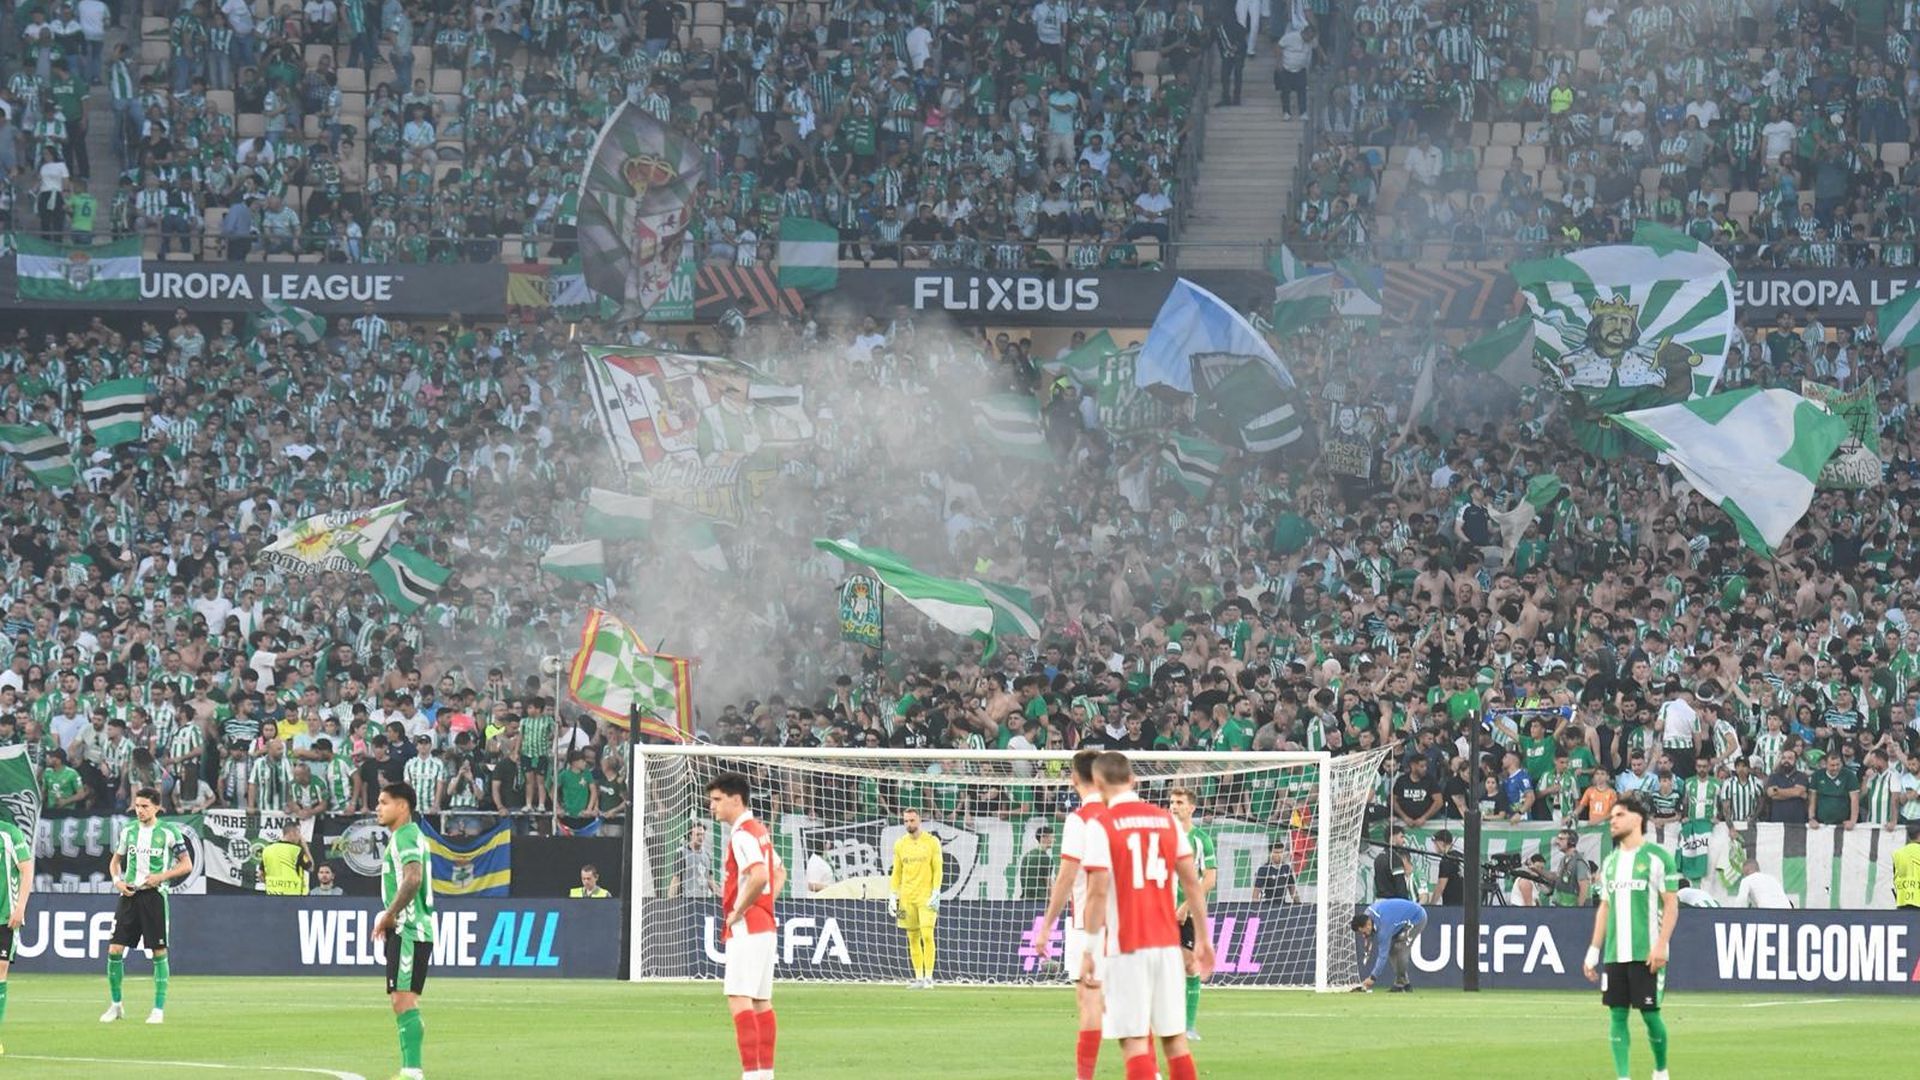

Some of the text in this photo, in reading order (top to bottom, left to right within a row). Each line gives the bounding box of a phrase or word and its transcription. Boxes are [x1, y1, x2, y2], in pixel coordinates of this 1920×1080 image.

[140, 272, 394, 302] UROPA LEAGUE
[914, 276, 1100, 312] FLiXBUS
[1733, 279, 1920, 307] EUROPA LE
[35, 814, 129, 859] REEN
[206, 814, 301, 831] ORREBLANCA
[1127, 832, 1168, 889] 14
[267, 880, 299, 888] CURITY
[297, 910, 560, 967] WELME ALL
[704, 916, 851, 966] UFA
[1410, 924, 1566, 974] UEFA
[1714, 923, 1908, 982] WELCOME
